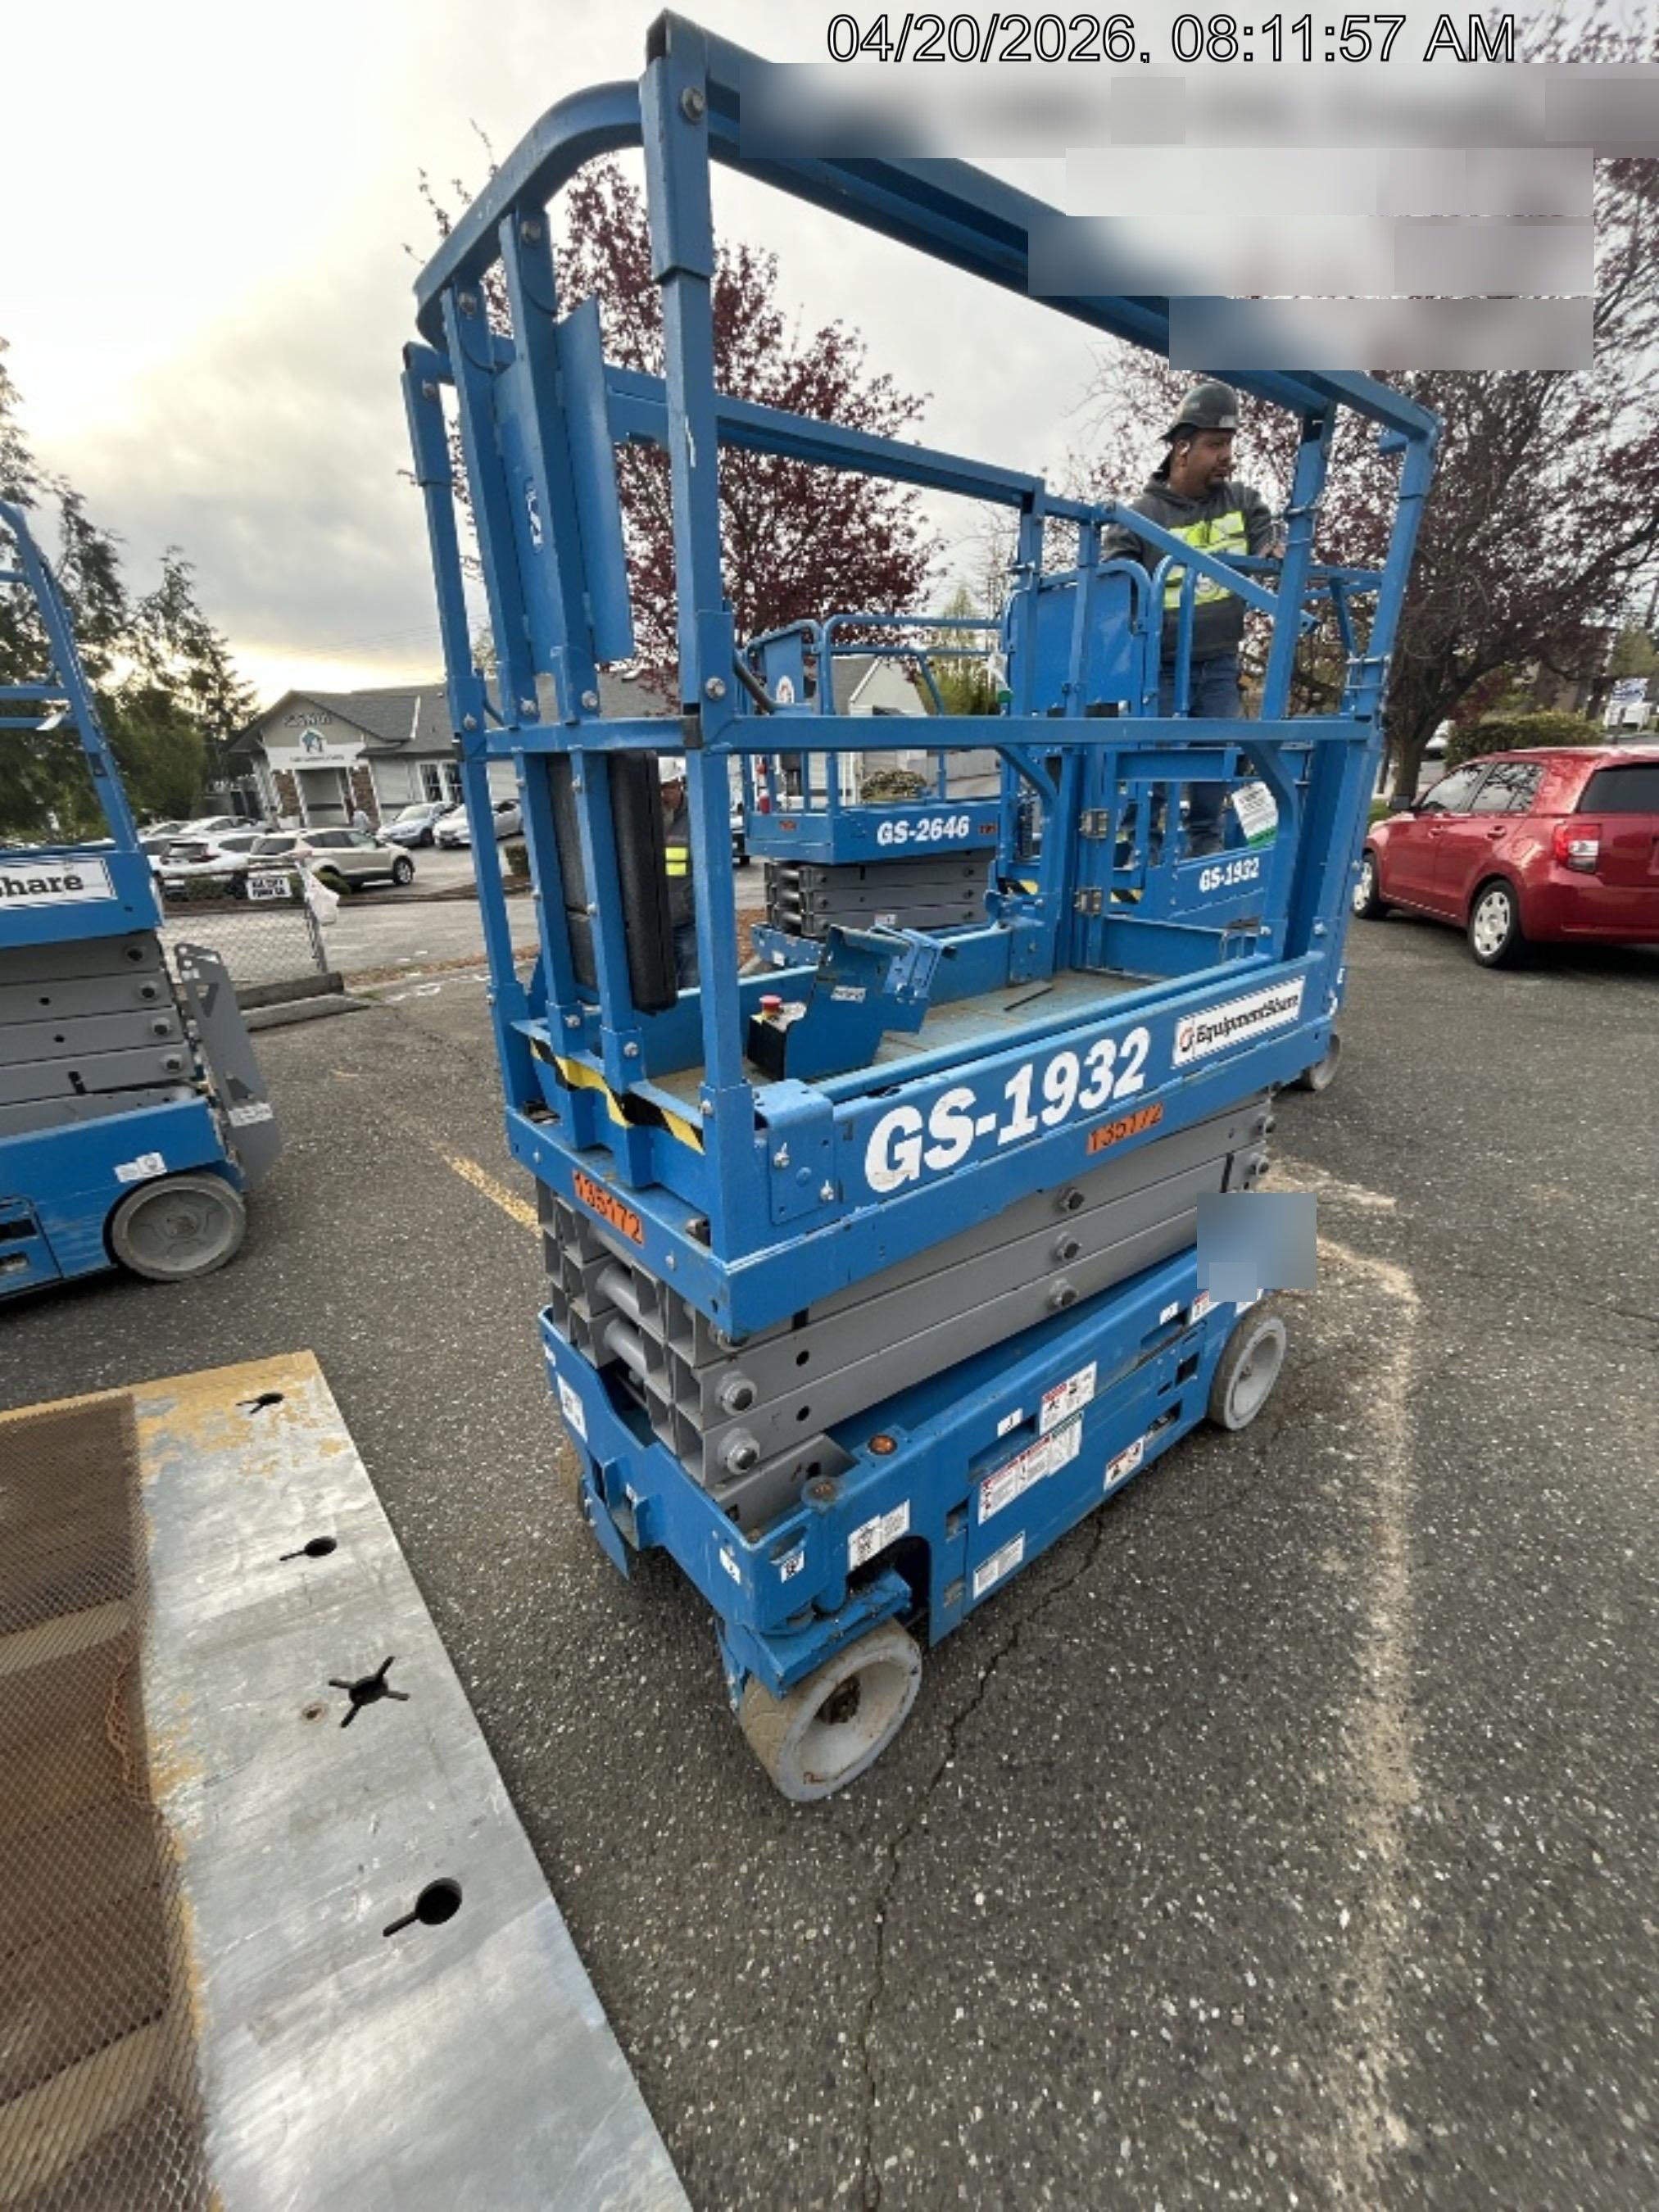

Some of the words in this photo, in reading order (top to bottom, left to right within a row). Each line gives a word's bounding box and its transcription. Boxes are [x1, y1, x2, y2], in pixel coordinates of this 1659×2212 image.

[877, 815, 970, 846] GS-2646
[0, 874, 84, 898] hare
[1199, 857, 1259, 893] GS-1932
[864, 1027, 1151, 1192] GS-1932
